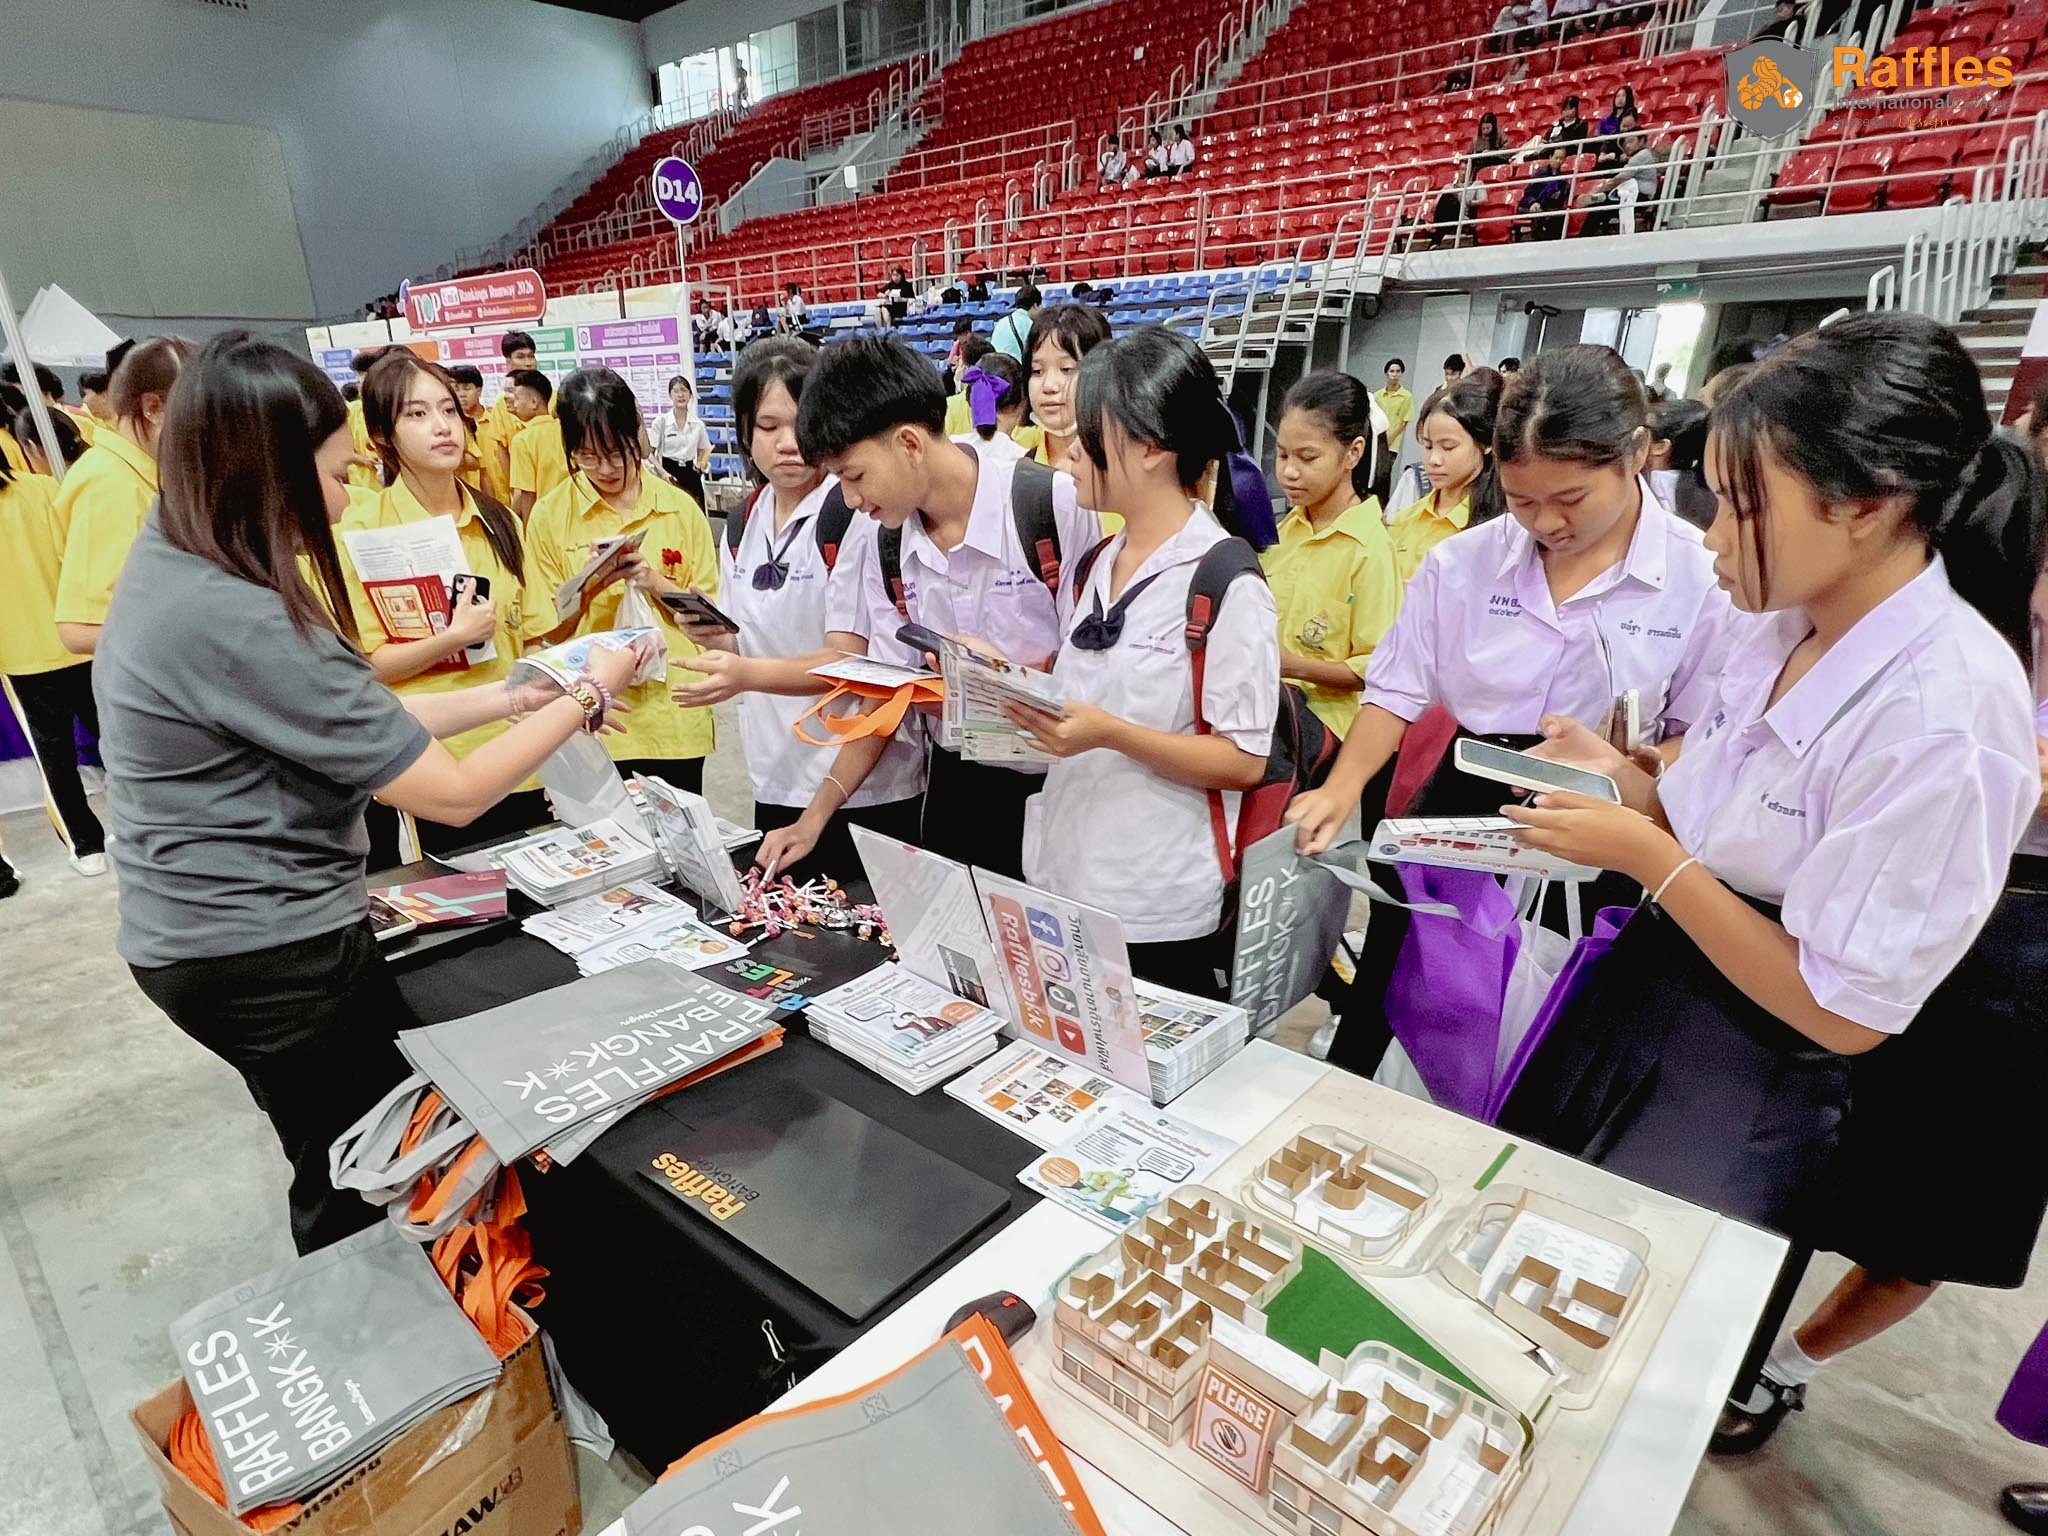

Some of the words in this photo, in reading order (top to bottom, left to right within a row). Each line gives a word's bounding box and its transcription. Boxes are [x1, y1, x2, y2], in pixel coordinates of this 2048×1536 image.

[657, 176, 698, 205] D14
[410, 291, 441, 325] TOP
[1232, 877, 1276, 1023] AFFLES
[533, 1018, 753, 1124] RAFFLES
[650, 1151, 748, 1221] Raffles
[186, 1329, 296, 1496] RAFFLES
[1206, 1375, 1268, 1431] PLEASE
